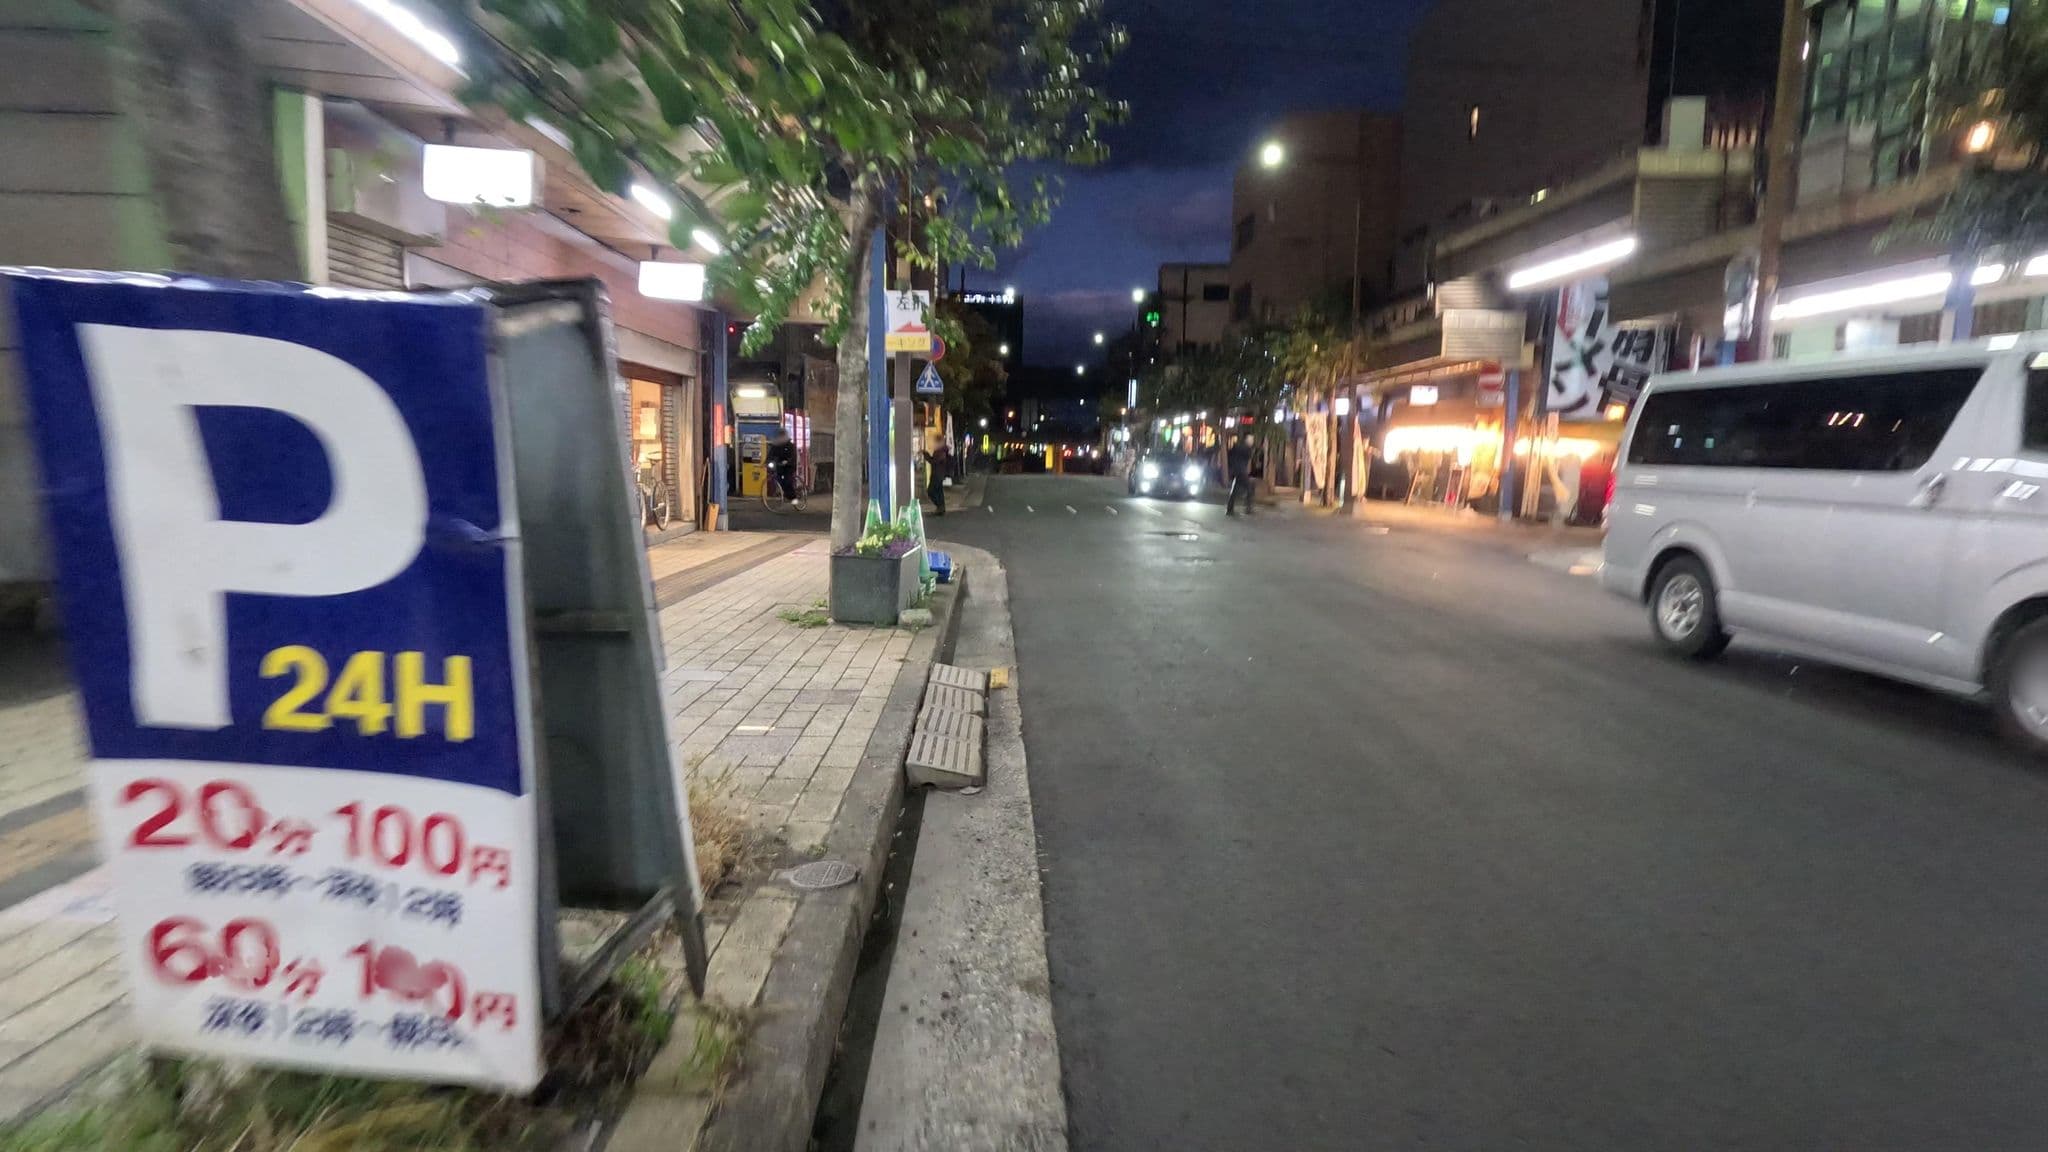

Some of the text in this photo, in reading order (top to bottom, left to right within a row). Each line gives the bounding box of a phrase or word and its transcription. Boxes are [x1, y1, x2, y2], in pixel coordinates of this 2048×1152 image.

[75, 322, 429, 730] P
[260, 645, 475, 741] 24H
[124, 778, 510, 889] 20分 100円
[147, 915, 517, 1032] 60分 10円
